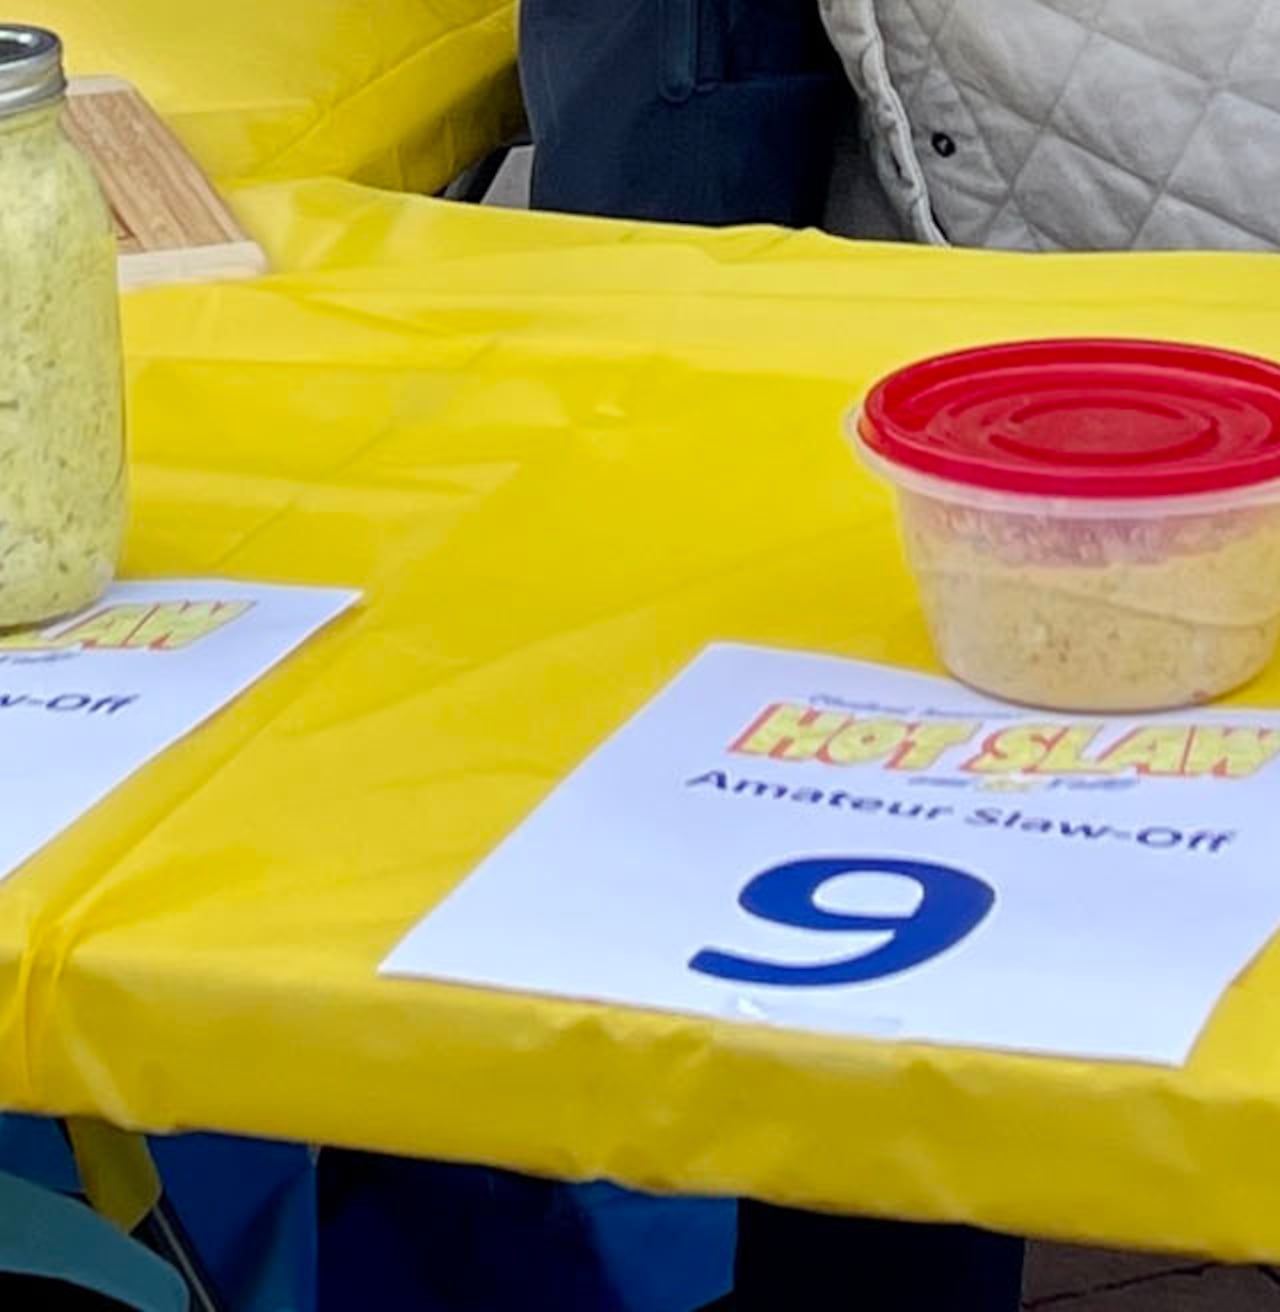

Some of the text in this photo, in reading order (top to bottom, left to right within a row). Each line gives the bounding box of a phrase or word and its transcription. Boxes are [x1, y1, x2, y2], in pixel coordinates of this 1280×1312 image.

[725, 700, 986, 773] HOT
[686, 768, 1239, 854] Amateur Slaw-Off
[686, 853, 997, 988] 9
